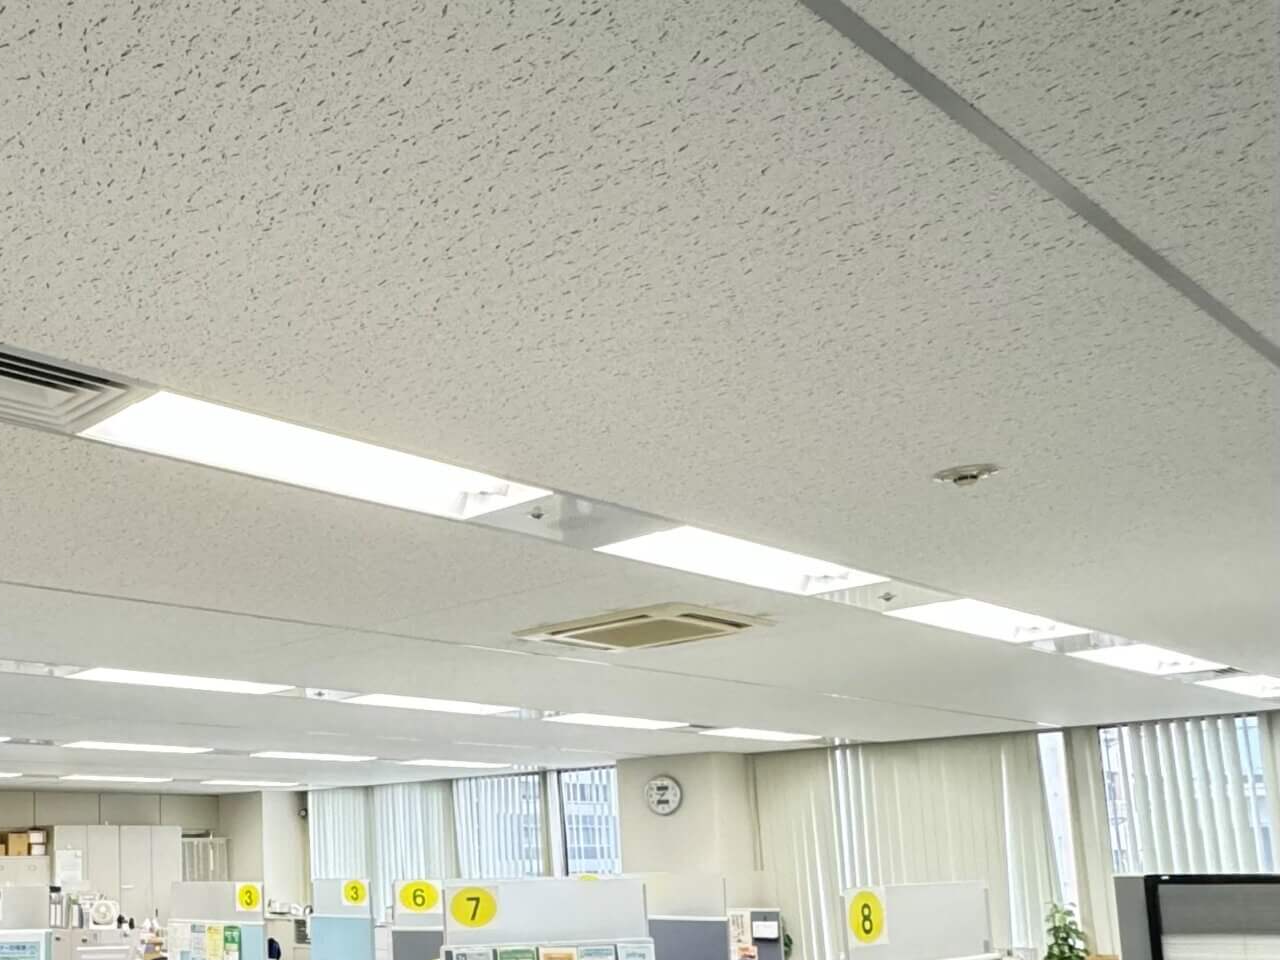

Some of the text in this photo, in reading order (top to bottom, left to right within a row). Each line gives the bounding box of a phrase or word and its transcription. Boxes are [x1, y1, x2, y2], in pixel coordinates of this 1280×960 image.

[244, 890, 253, 906] 3
[351, 886, 359, 900] 3
[412, 888, 425, 907] 6
[466, 897, 480, 920] 7
[861, 903, 873, 935] 8
